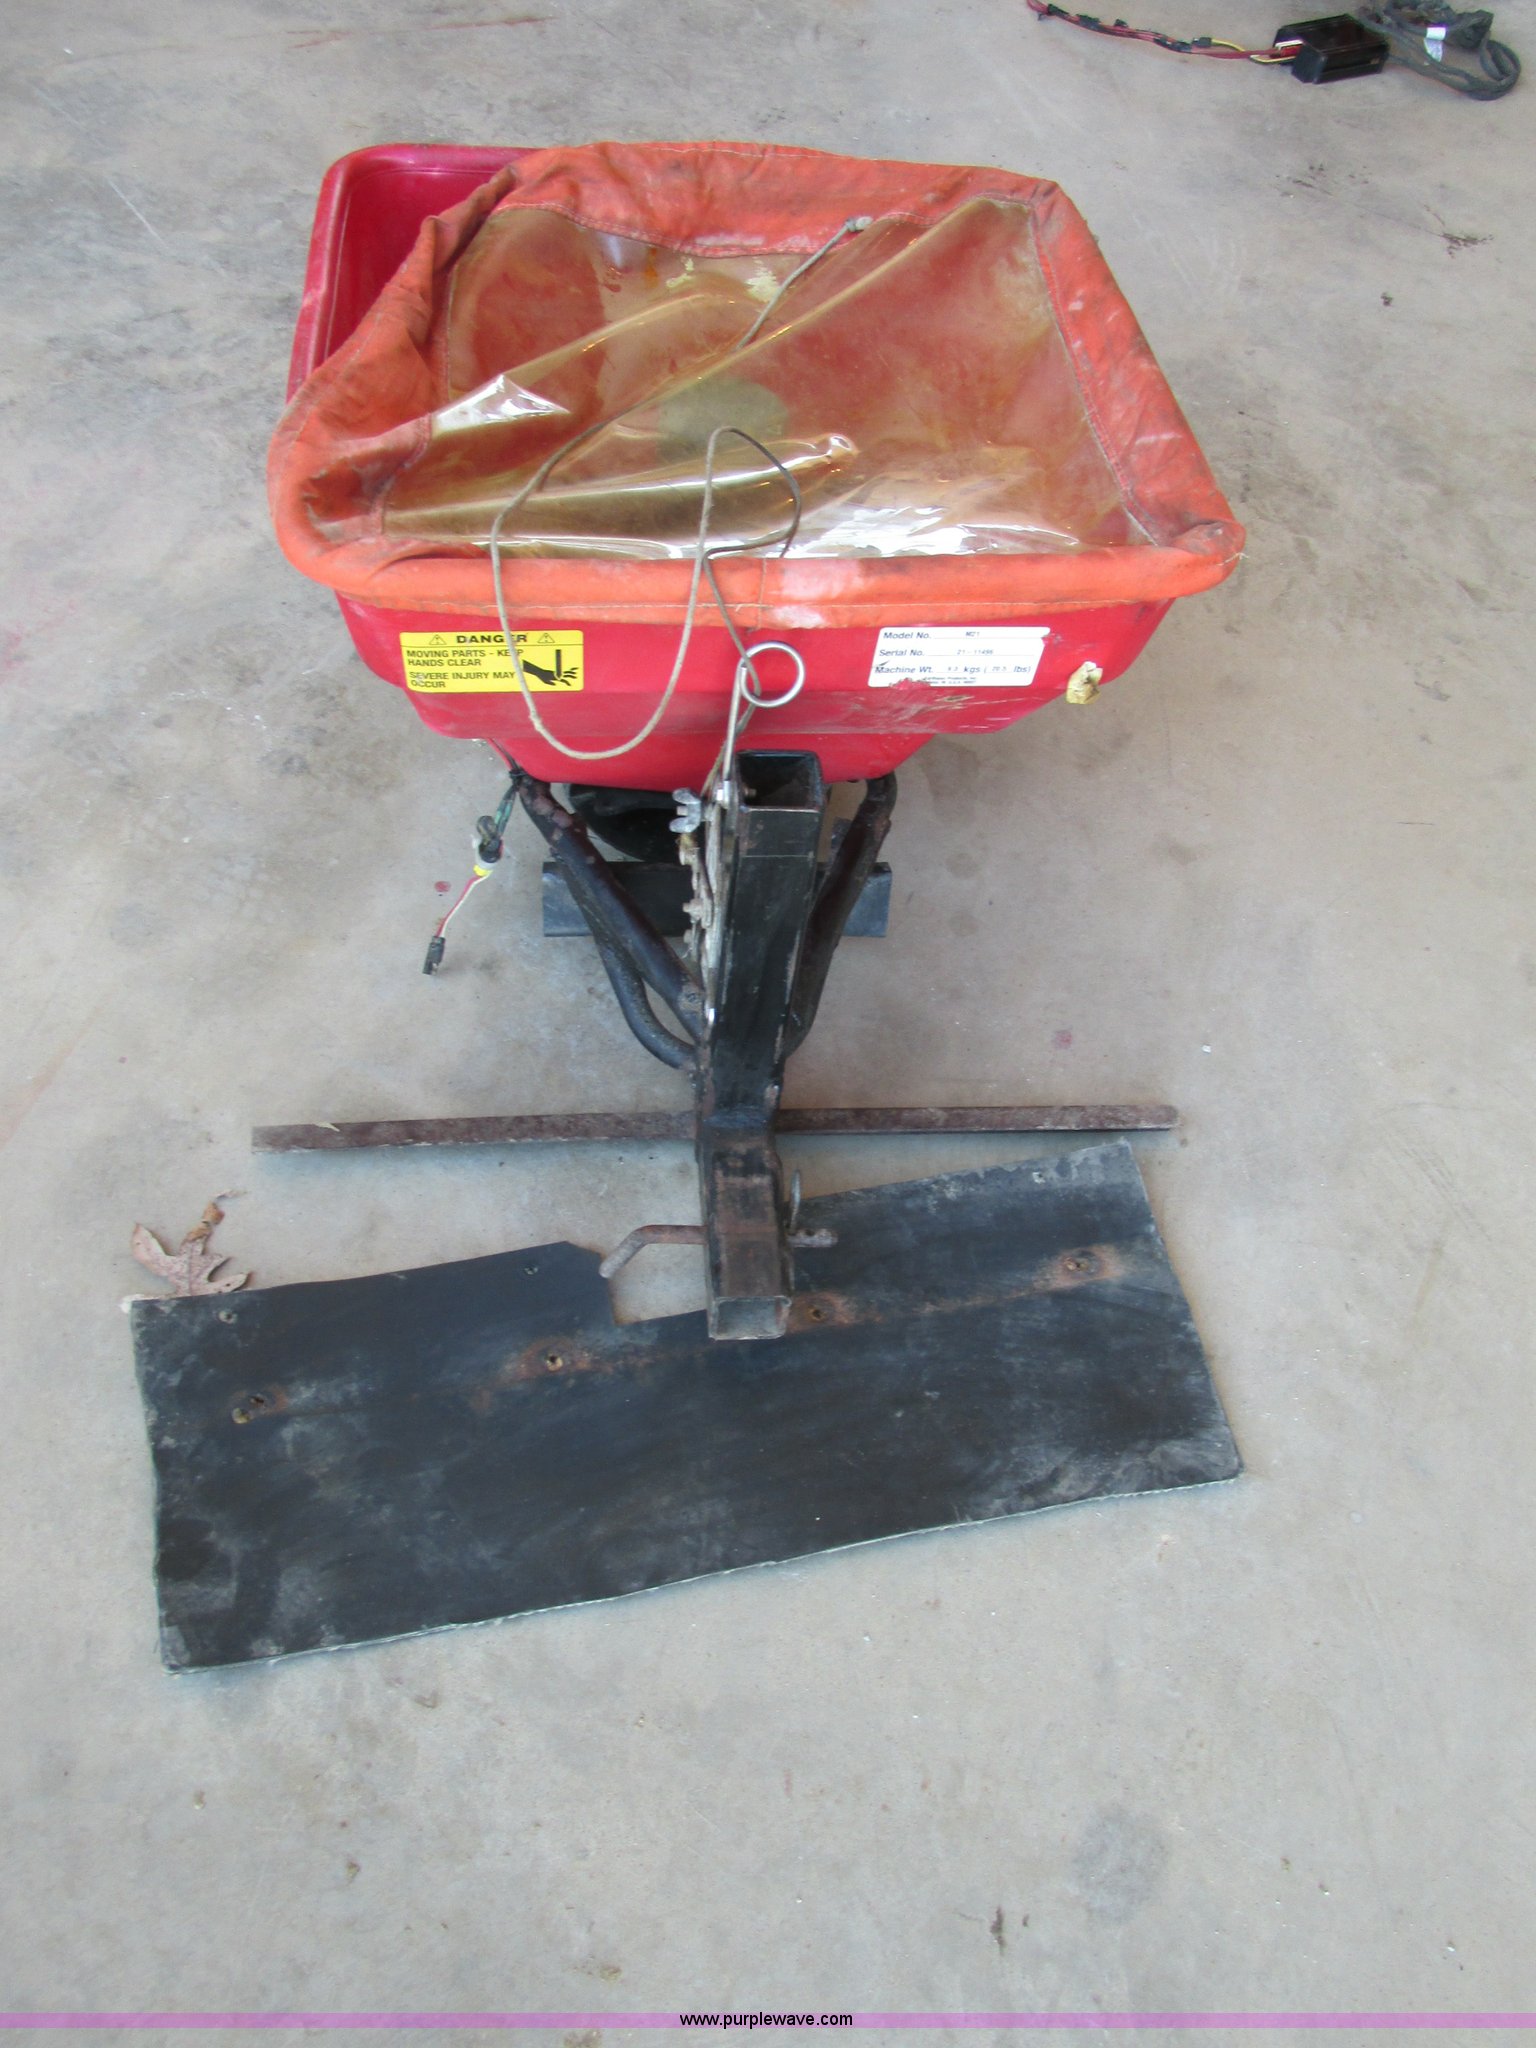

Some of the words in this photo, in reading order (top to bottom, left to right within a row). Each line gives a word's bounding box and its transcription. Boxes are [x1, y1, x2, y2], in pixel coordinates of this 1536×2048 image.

[407, 649, 449, 658] MOVING
[452, 649, 486, 657] PARTS
[497, 649, 524, 657] KEP
[408, 658, 444, 667] HANDS
[448, 658, 481, 666] CLEAR
[874, 665, 916, 673] Machine
[963, 665, 980, 675] kgs
[409, 671, 449, 680] SEVERE
[452, 671, 488, 680] INJURY
[493, 671, 516, 679] MAY
[411, 680, 446, 688] OCCUR
